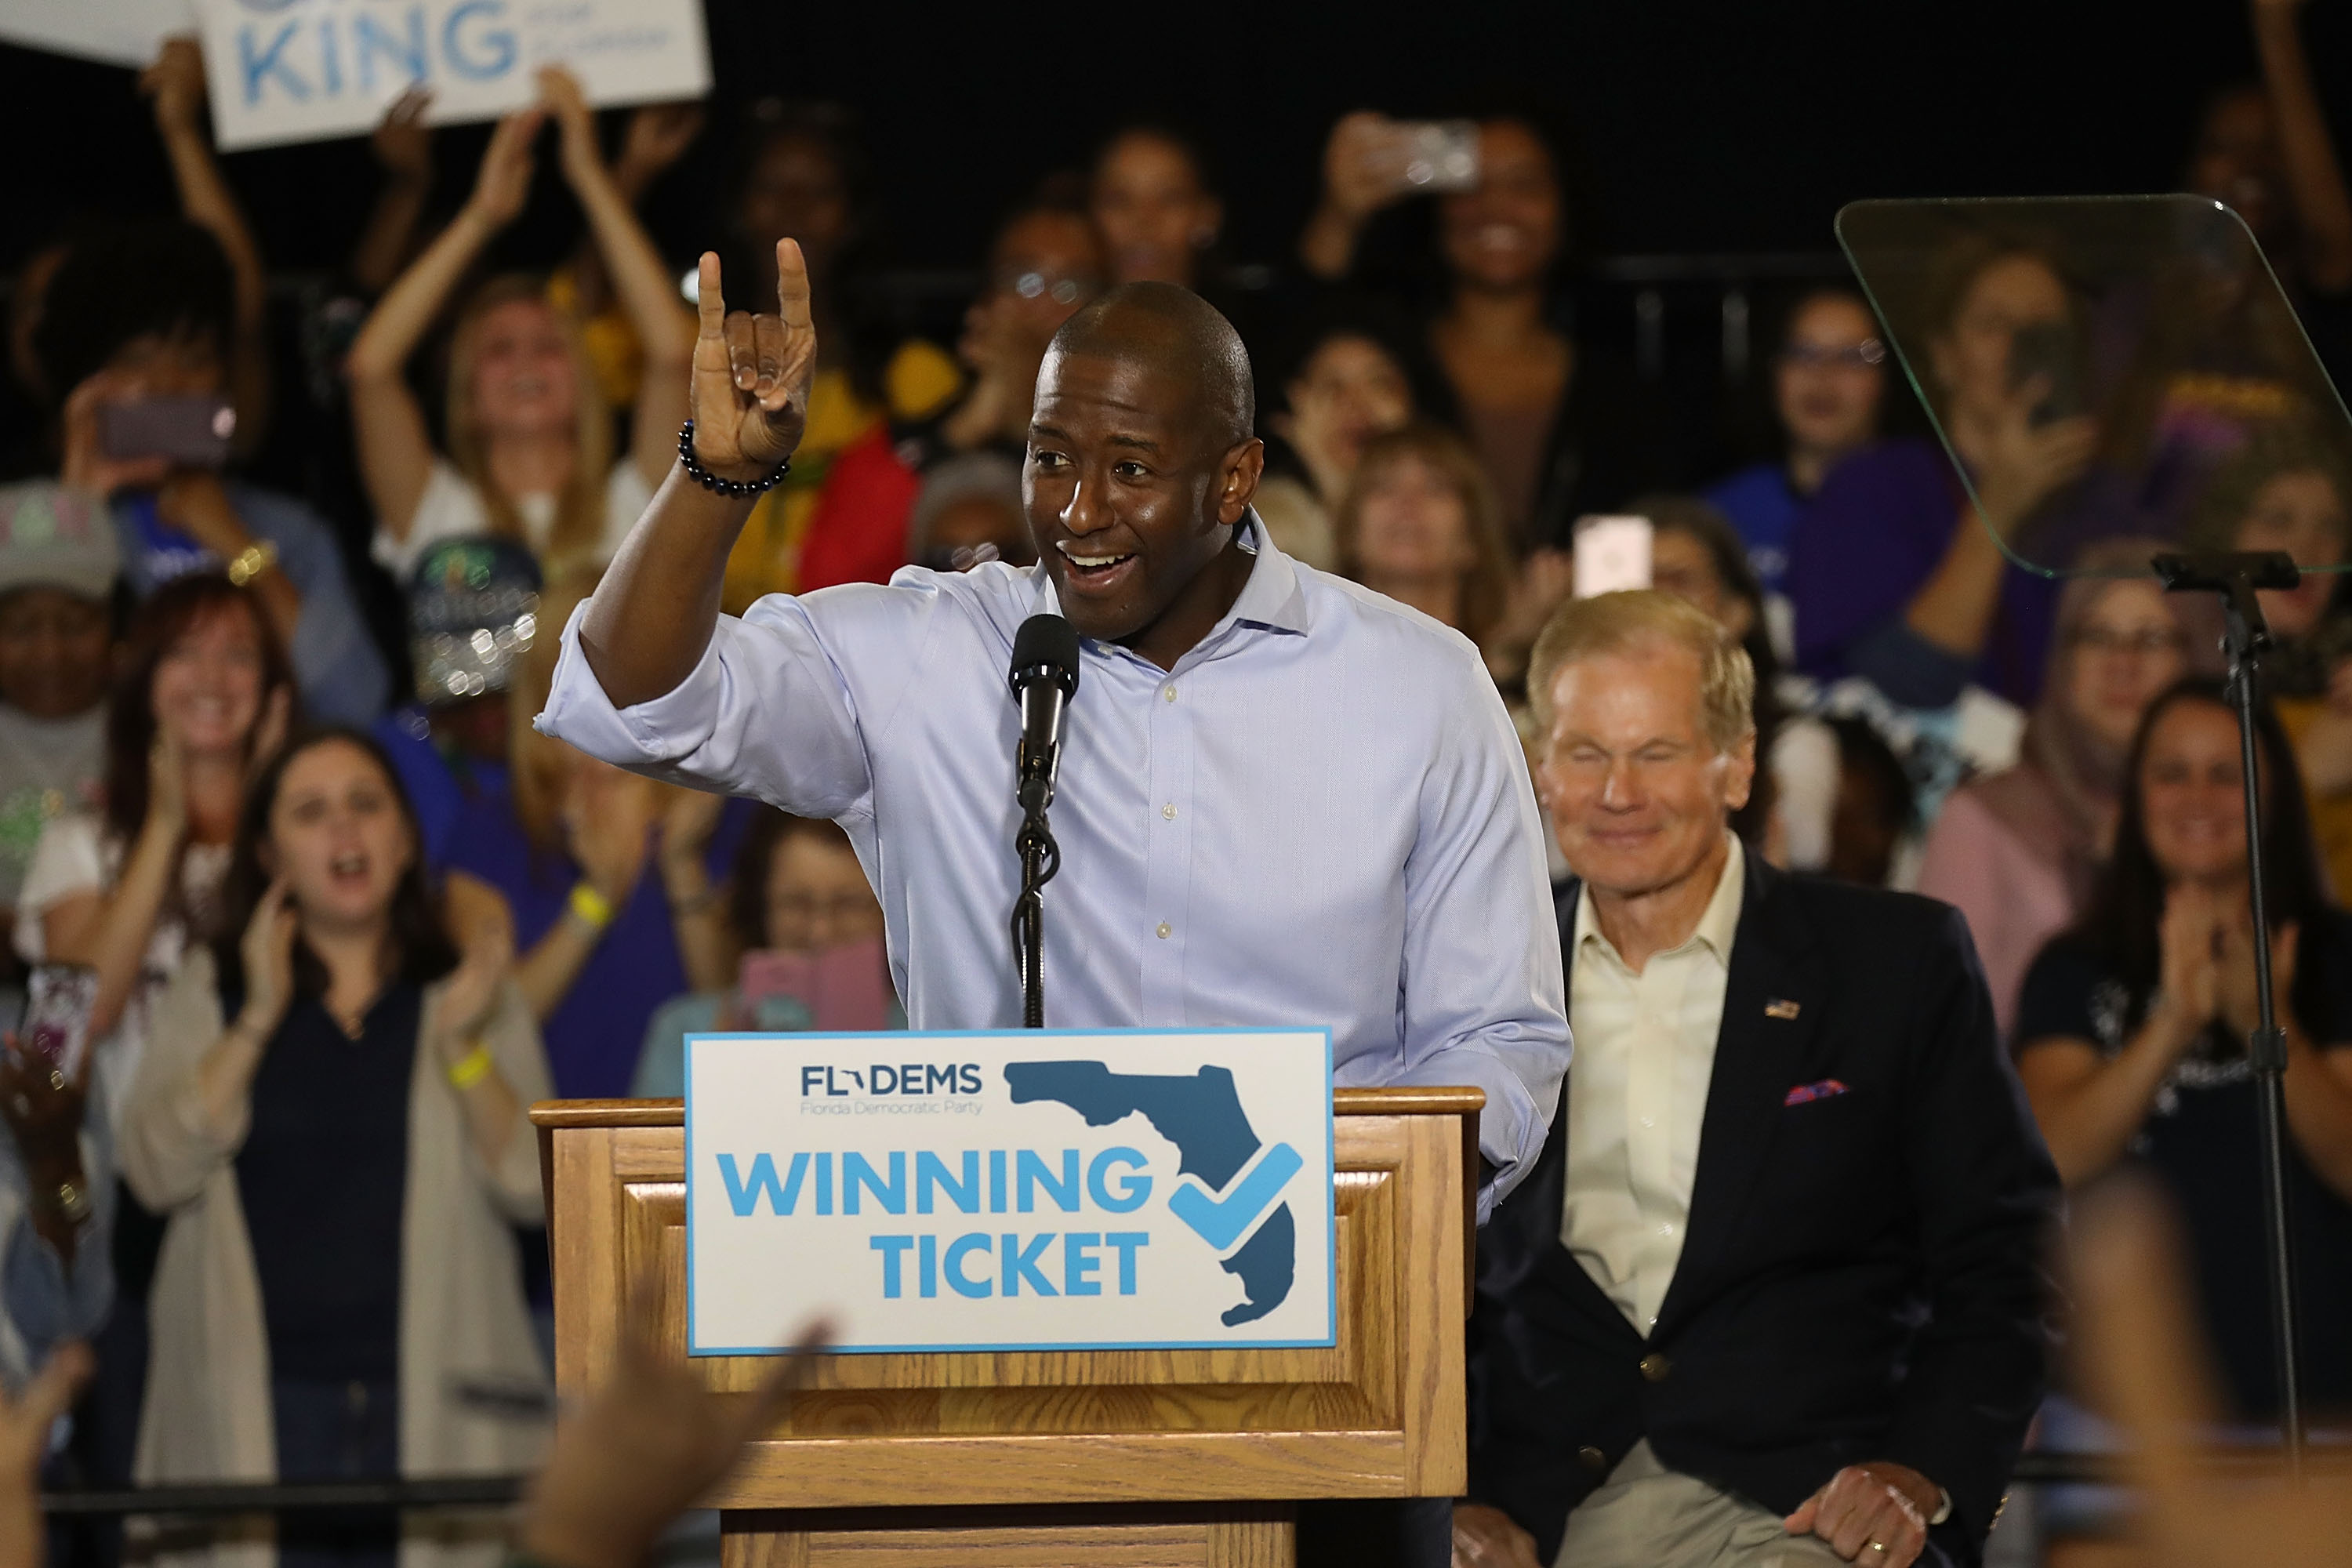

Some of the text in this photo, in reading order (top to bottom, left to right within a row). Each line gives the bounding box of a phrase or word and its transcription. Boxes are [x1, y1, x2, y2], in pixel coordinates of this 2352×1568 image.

[235, 0, 517, 105] KING
[800, 1100, 983, 1116] Florida Democratic Party
[716, 1146, 1153, 1217] WINNING
[869, 1232, 1149, 1299] TICKET
